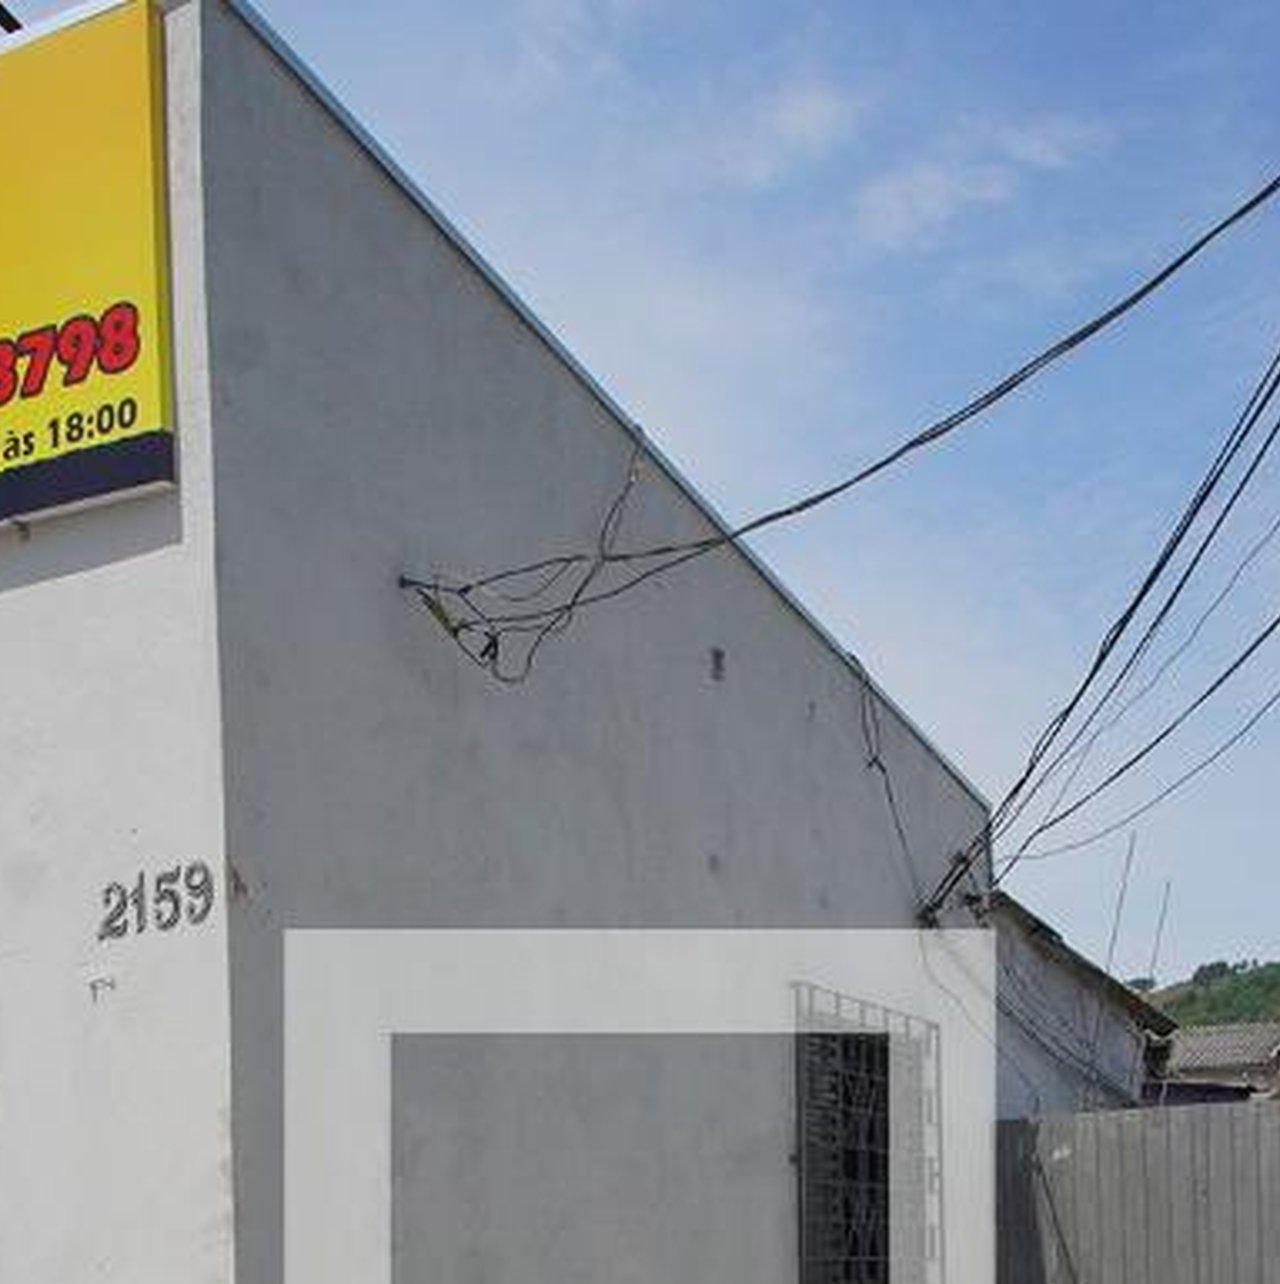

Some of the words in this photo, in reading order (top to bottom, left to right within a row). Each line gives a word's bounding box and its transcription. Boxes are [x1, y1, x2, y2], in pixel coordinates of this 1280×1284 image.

[3, 430, 36, 460] às
[47, 397, 138, 451] 18:00
[98, 861, 214, 941] 2159
